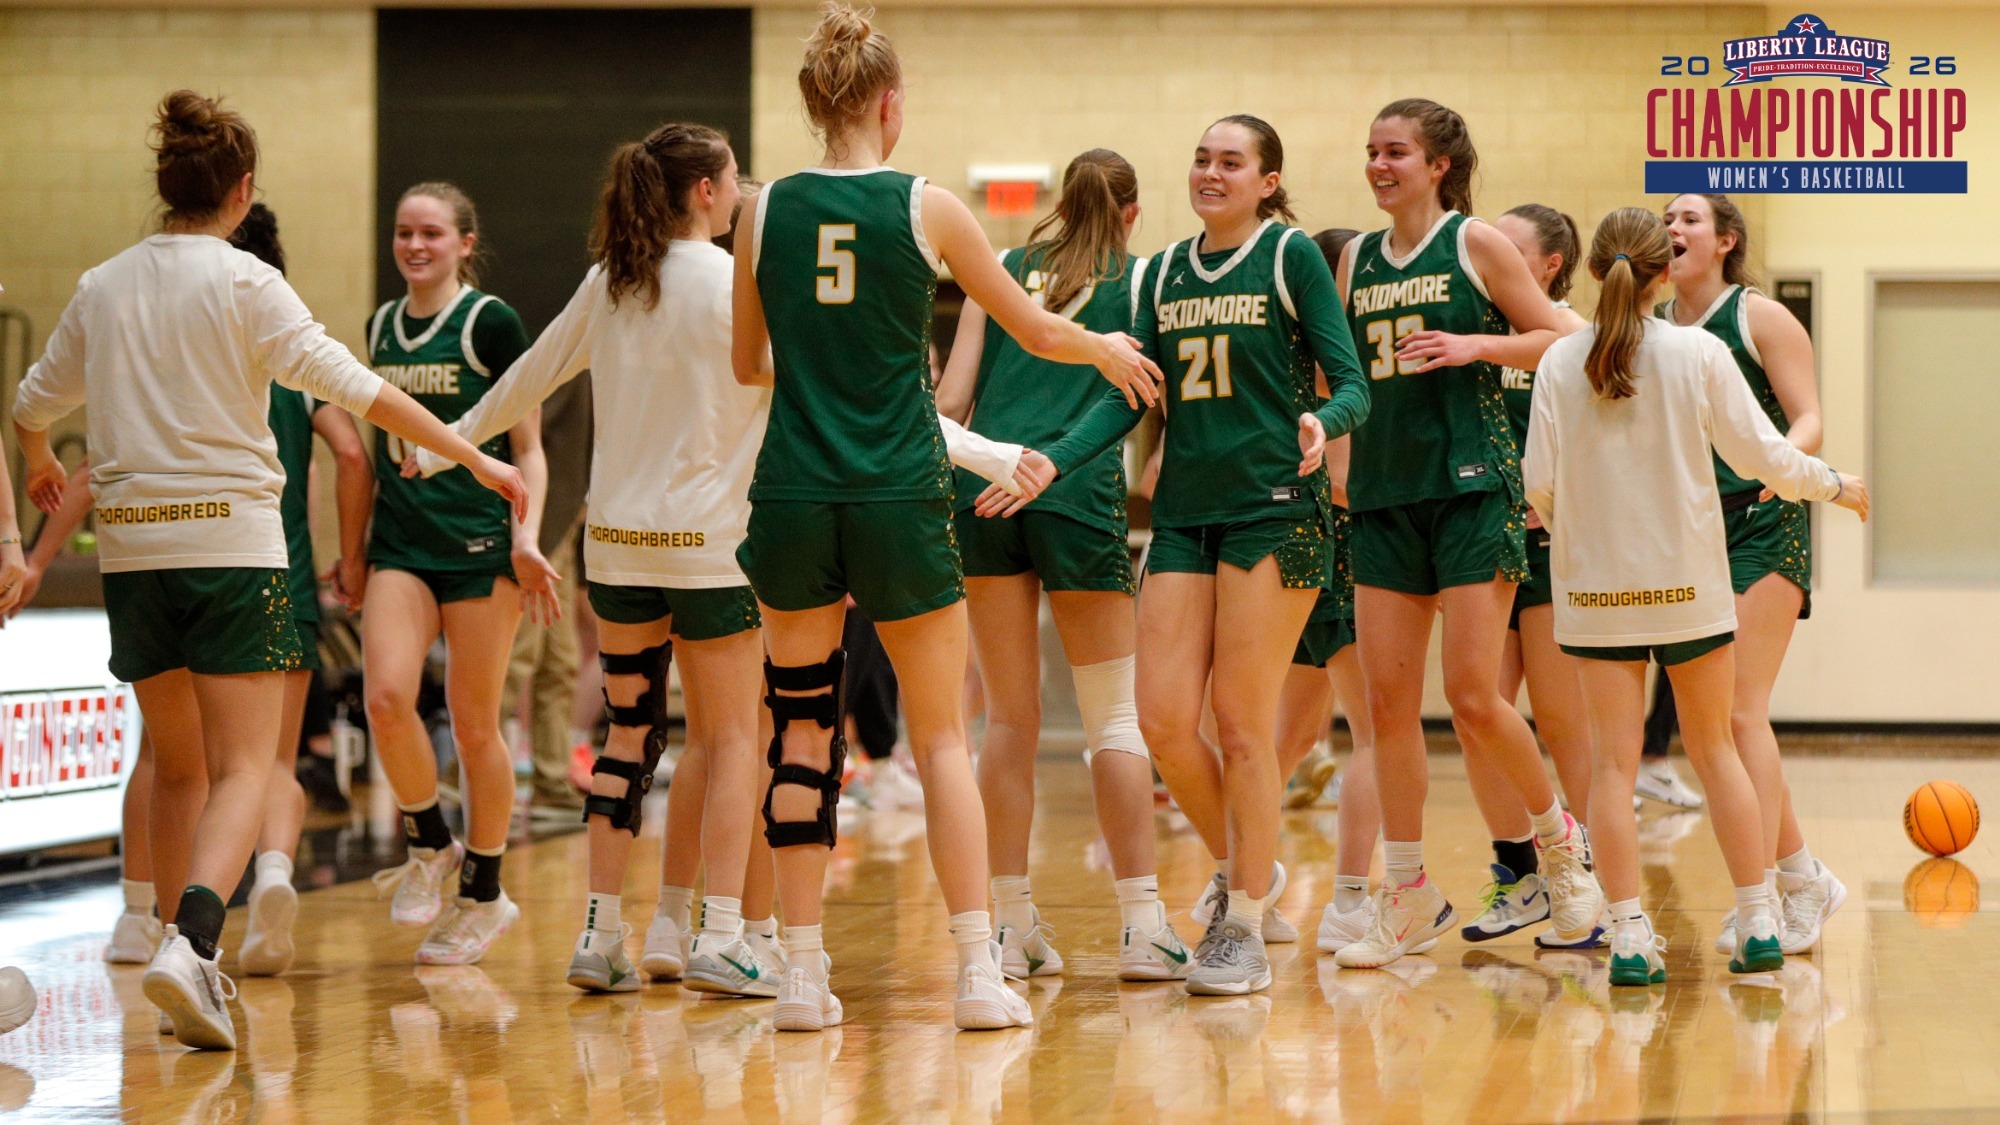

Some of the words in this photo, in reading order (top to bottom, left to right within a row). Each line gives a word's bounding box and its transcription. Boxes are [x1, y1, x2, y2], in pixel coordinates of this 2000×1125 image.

[816, 223, 856, 304] 5
[1352, 273, 1451, 318] SKIDMORE
[1158, 294, 1268, 334] SKIDMORE
[373, 363, 461, 395] DMORE
[1178, 334, 1233, 401] 21
[96, 501, 231, 525] THOROUGHBREDS
[587, 523, 705, 548] THOROUGHBREDS
[1567, 586, 1696, 607] THOROUGHBREDS
